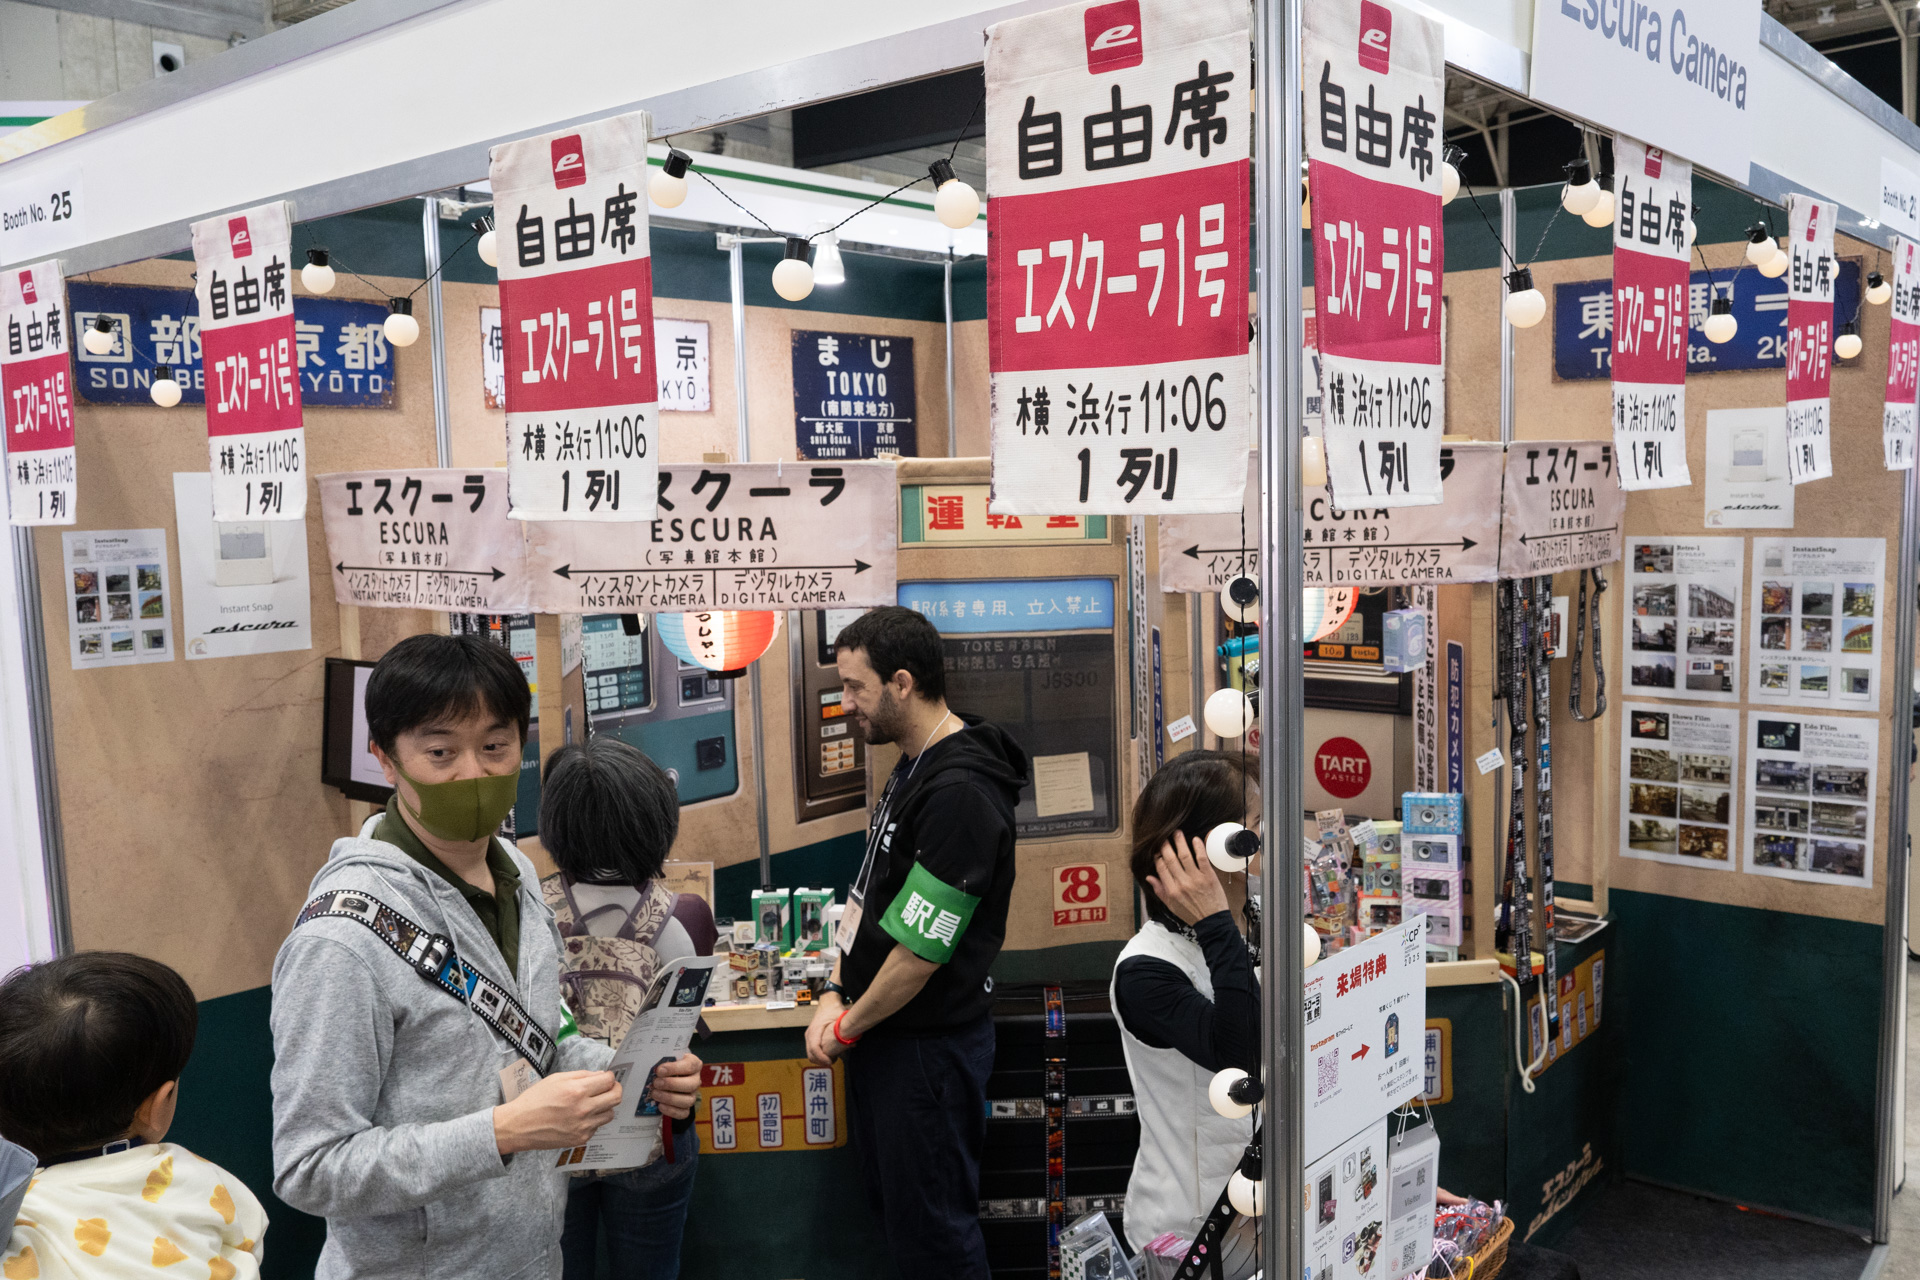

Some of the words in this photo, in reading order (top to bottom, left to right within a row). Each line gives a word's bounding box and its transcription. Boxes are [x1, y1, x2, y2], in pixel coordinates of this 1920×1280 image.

[1670, 9, 1746, 110] Camera
[1018, 60, 1235, 180] 自由席
[1320, 60, 1436, 182] 自由席
[3, 207, 28, 231] Booth
[30, 203, 47, 222] No.
[51, 191, 72, 221] 25
[517, 183, 637, 267] 自由席
[1620, 174, 1686, 253] 自由席
[210, 255, 286, 320] 自由席
[1015, 203, 1229, 333] エスクーラ1号
[1324, 220, 1433, 331] エスクーラ1号
[1793, 244, 1831, 297] 自由席
[8, 303, 61, 355] 自由席
[521, 288, 642, 383] エスクーラ1号
[1617, 284, 1683, 361] エスクーラ1号
[1688, 343, 1717, 363] ta.
[1757, 335, 1788, 360] 2k
[90, 368, 205, 389] SONBE
[215, 337, 294, 414] エスクーラ1号
[827, 371, 886, 396] TOKYO
[14, 372, 70, 433] エスクーラ1号
[1016, 372, 1226, 436] 横浜行11:06
[1329, 371, 1432, 429] 横浜行11:06
[1617, 394, 1676, 432] 横浜行11:06
[523, 414, 647, 461] 横浜行11:06
[810, 436, 827, 445] SHIN
[815, 422, 843, 434] 新大阪
[877, 422, 894, 434] 京都
[17, 455, 73, 485] 横浜行11:06
[220, 437, 299, 475] 横浜行11:06
[817, 448, 846, 457] STATION
[1358, 439, 1410, 495] 1列
[1526, 446, 1611, 485] エスクーラ
[1632, 441, 1663, 480] 1列
[562, 470, 620, 512] 1列
[657, 468, 845, 512] スクーラ
[1077, 447, 1178, 503] 1列
[38, 490, 66, 519] 1列
[245, 482, 282, 515] 1列
[346, 475, 486, 516] エスクーラ
[1551, 487, 1595, 511] ESCURA
[380, 521, 449, 546] ESCURA
[650, 517, 777, 543] ESCURA
[1304, 526, 1389, 542] 真館本館)
[1792, 545, 1837, 553] InstantSnap
[645, 548, 777, 566] (写真館本館)
[1337, 568, 1395, 580] DIGITAL
[1401, 567, 1453, 579] CAMERA
[1349, 548, 1440, 568] デジタルカメラ
[350, 589, 381, 602] INSTANT
[382, 591, 411, 603] CAMERA
[418, 593, 452, 607] DIGITAL
[455, 596, 488, 608] CAMERA
[580, 575, 704, 594] インスタントカメラ
[734, 569, 833, 591] デジタルカメラ
[580, 594, 645, 608] INSTANT
[649, 593, 706, 607] CAMERA
[721, 592, 784, 604] DIGITAL
[790, 591, 846, 603] CAMERA
[205, 619, 298, 634] escura
[220, 604, 249, 615] Instant
[251, 601, 274, 614] Snap
[1450, 658, 1459, 793] 防犯カメラ
[1318, 754, 1367, 774] TART
[900, 891, 961, 947] 駅員
[1337, 953, 1386, 998] 来場特典
[1310, 1033, 1335, 1052] Instagram
[715, 1098, 732, 1144] 久保山
[761, 1097, 778, 1142] 初音町
[809, 1073, 829, 1137] 浦舟町
